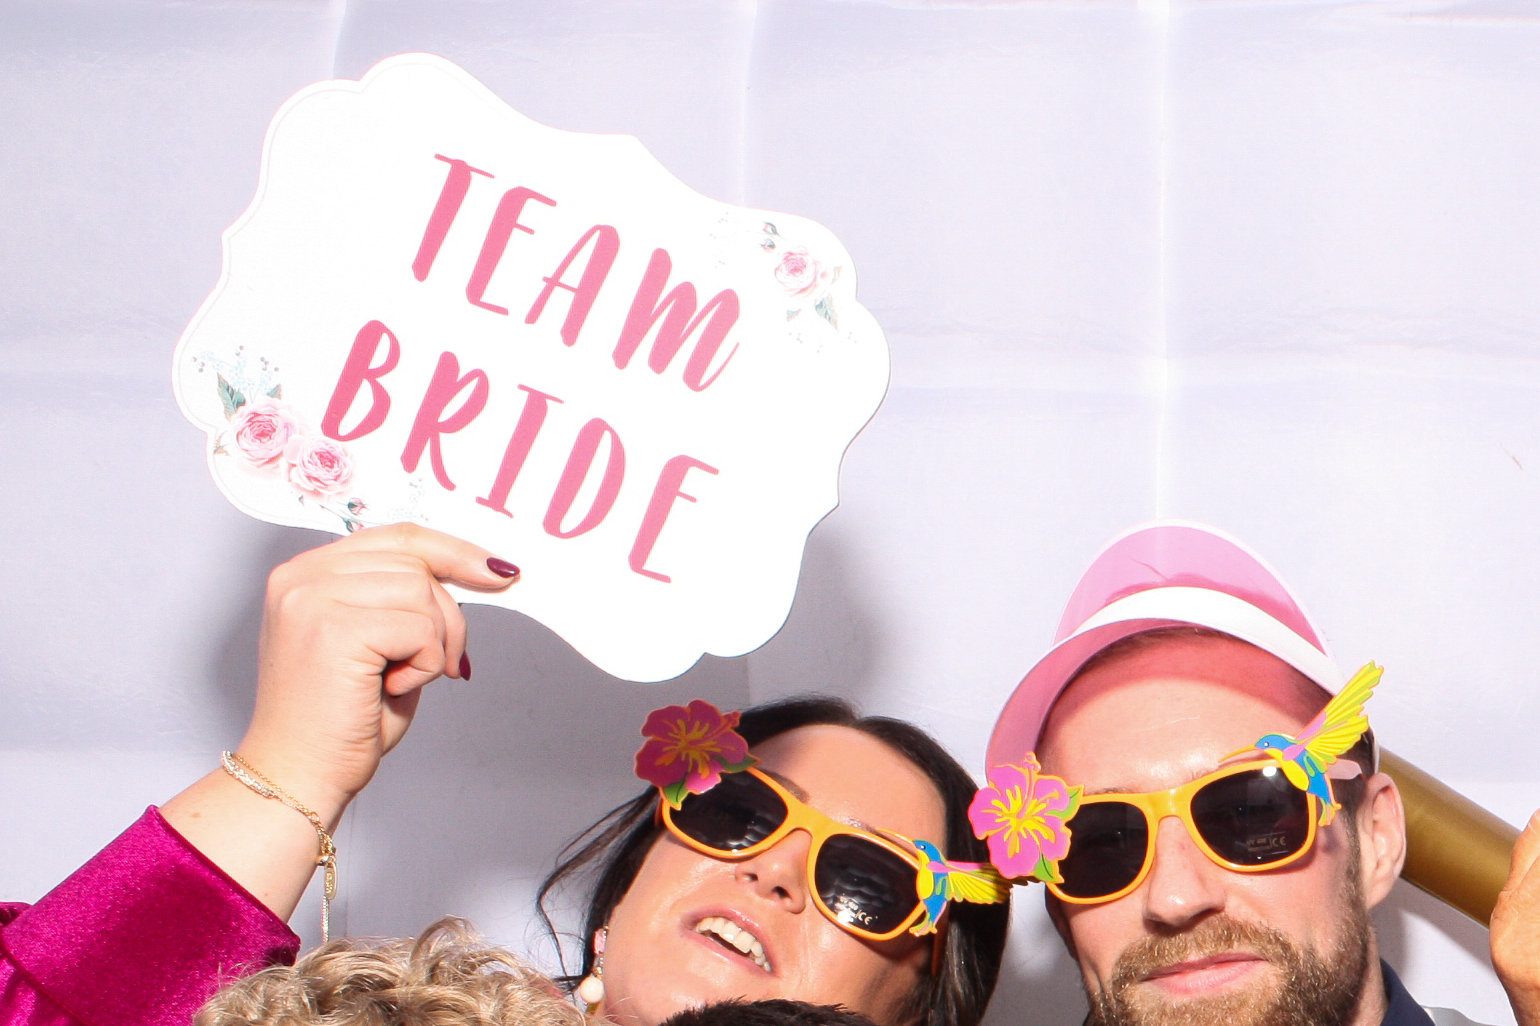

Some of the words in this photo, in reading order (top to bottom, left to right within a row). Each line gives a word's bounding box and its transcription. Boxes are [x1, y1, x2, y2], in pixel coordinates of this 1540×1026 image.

[411, 153, 740, 392] TEAM
[321, 319, 719, 584] BRIDE
[1272, 836, 1287, 847] CE
[858, 911, 873, 926] CE
